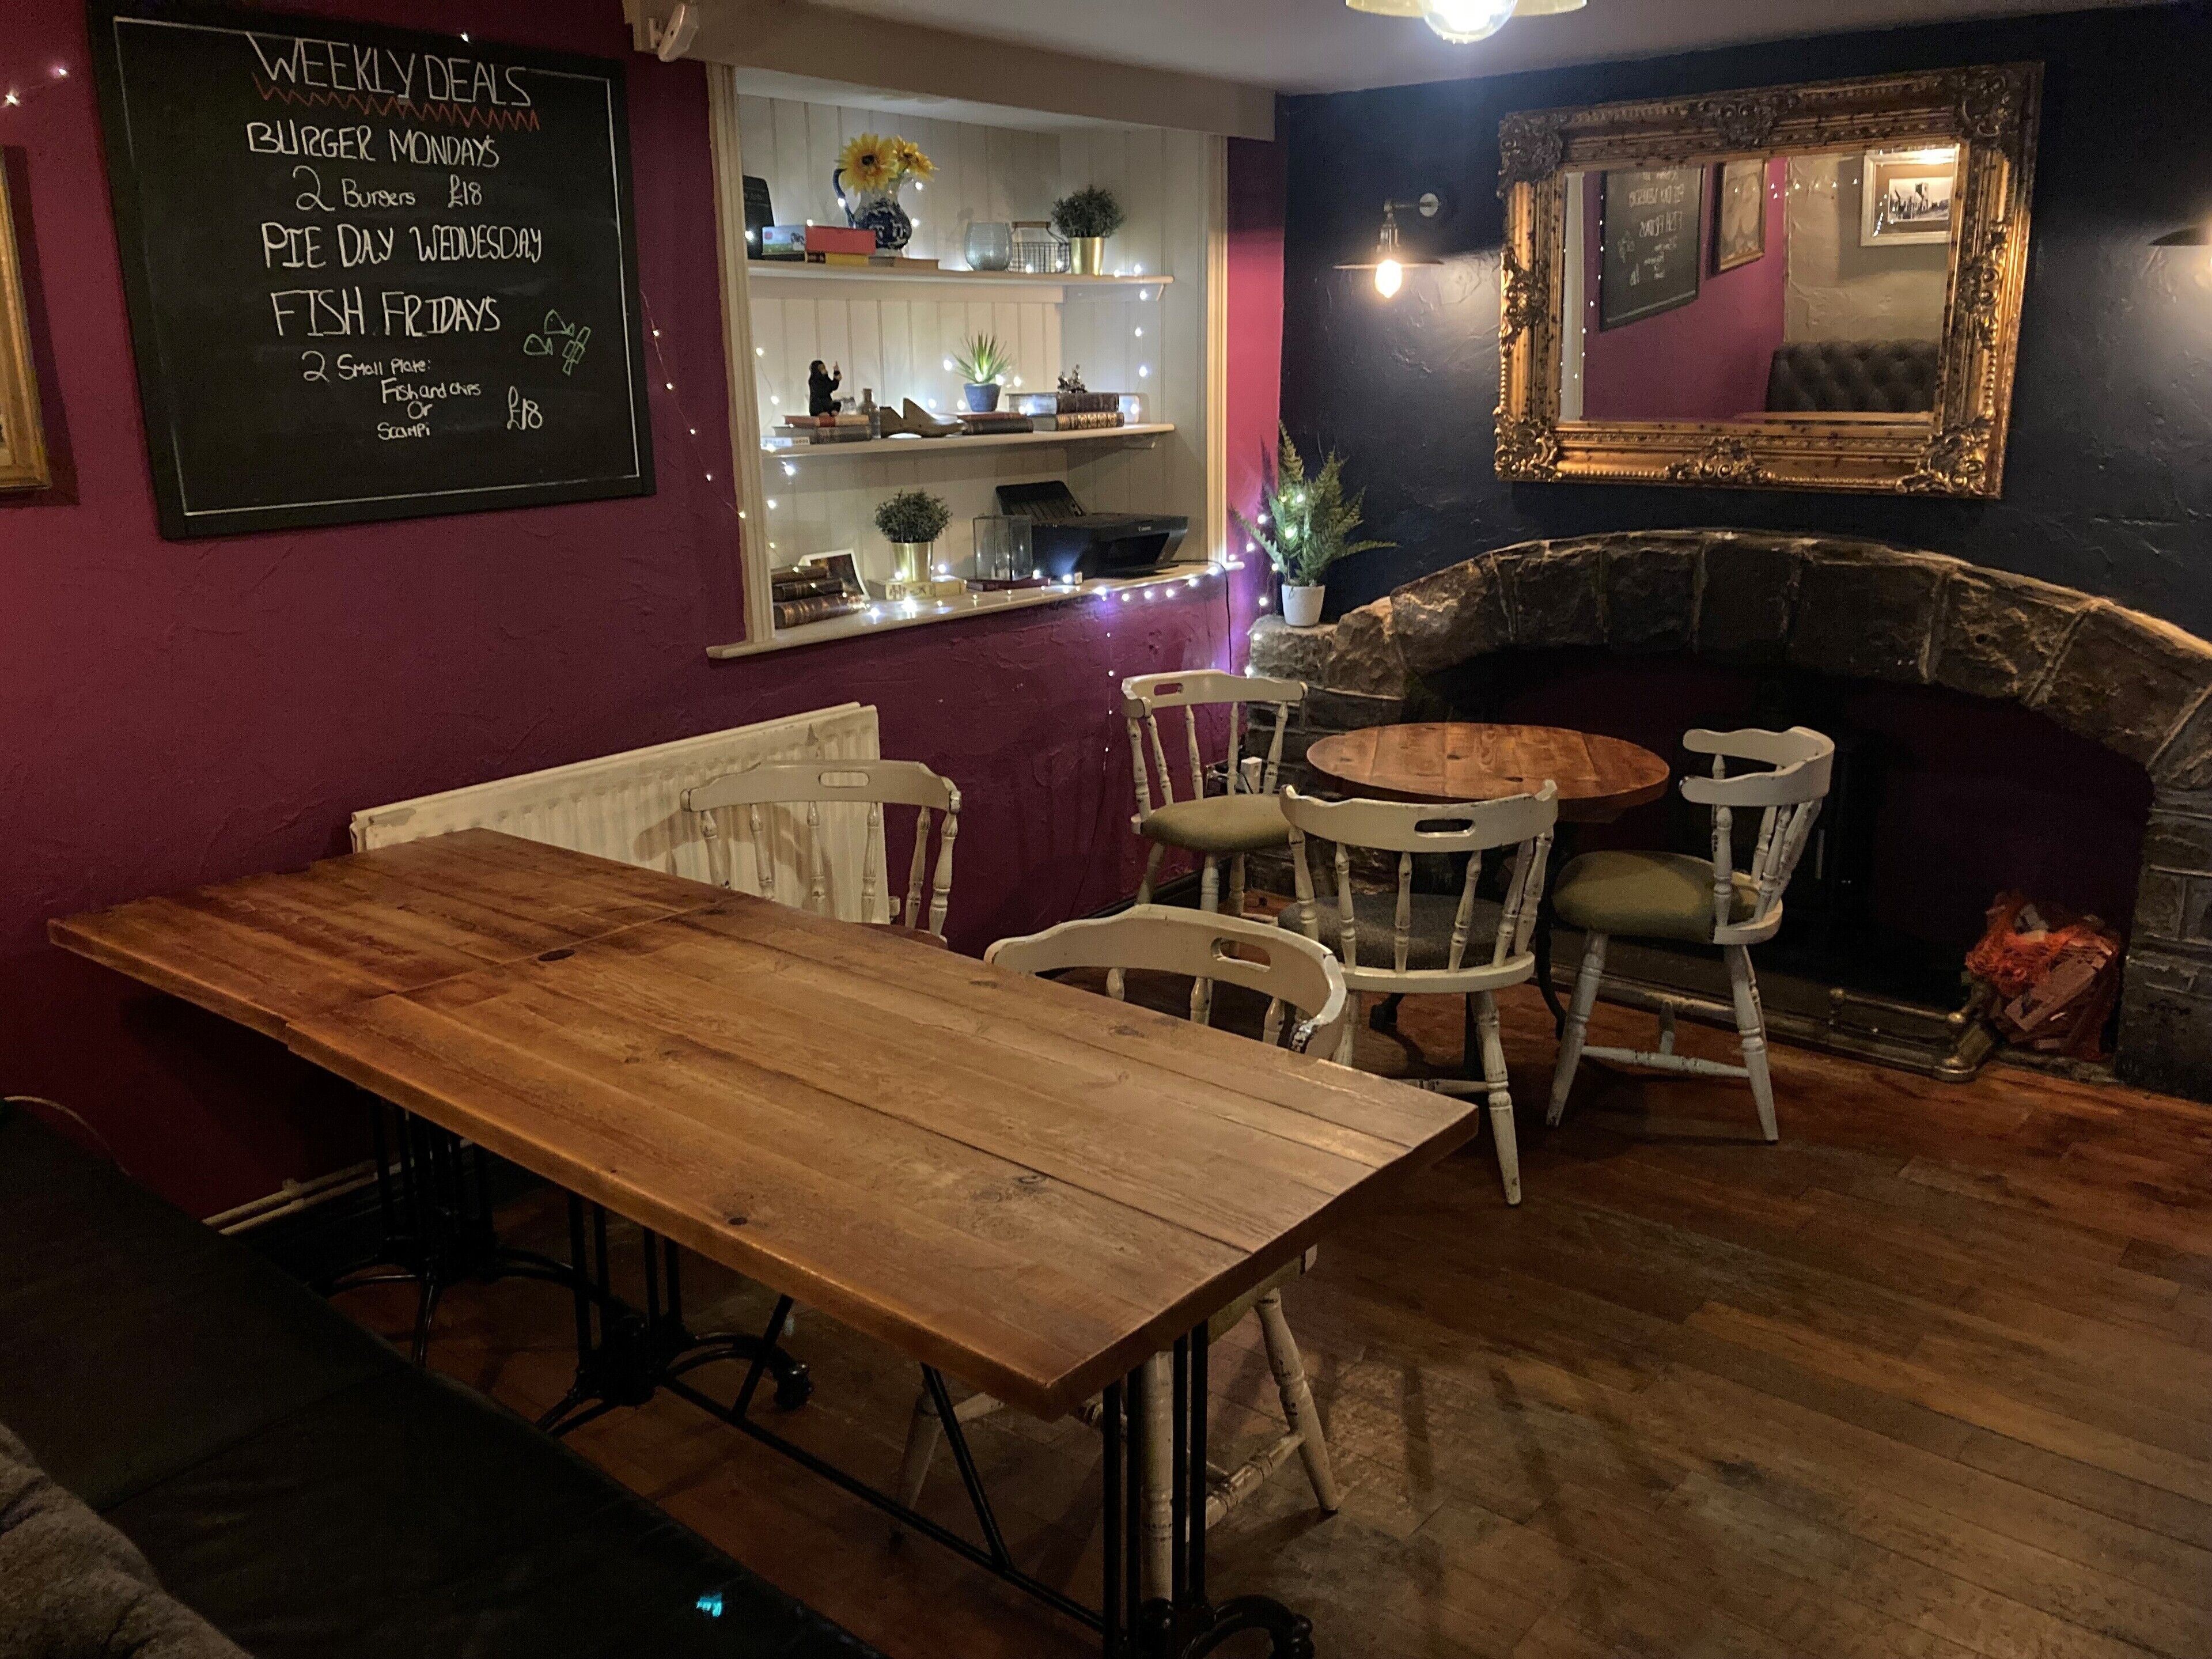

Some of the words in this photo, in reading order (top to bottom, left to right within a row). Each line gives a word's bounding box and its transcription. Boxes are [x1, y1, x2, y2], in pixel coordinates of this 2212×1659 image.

[245, 32, 415, 99] WEEKLY
[424, 55, 531, 106] DEALS
[246, 119, 376, 161] BURGER
[292, 165, 335, 212] 2
[340, 177, 416, 209] Burgers
[448, 173, 482, 209] £18
[261, 221, 327, 269] PIE
[337, 222, 394, 268] DAY
[408, 224, 543, 264] WEDNESDAY
[270, 286, 365, 336] FISH
[381, 291, 501, 338] FRIDAYS
[302, 350, 331, 384] 2
[419, 382, 446, 399] and
[506, 385, 543, 430] £18
